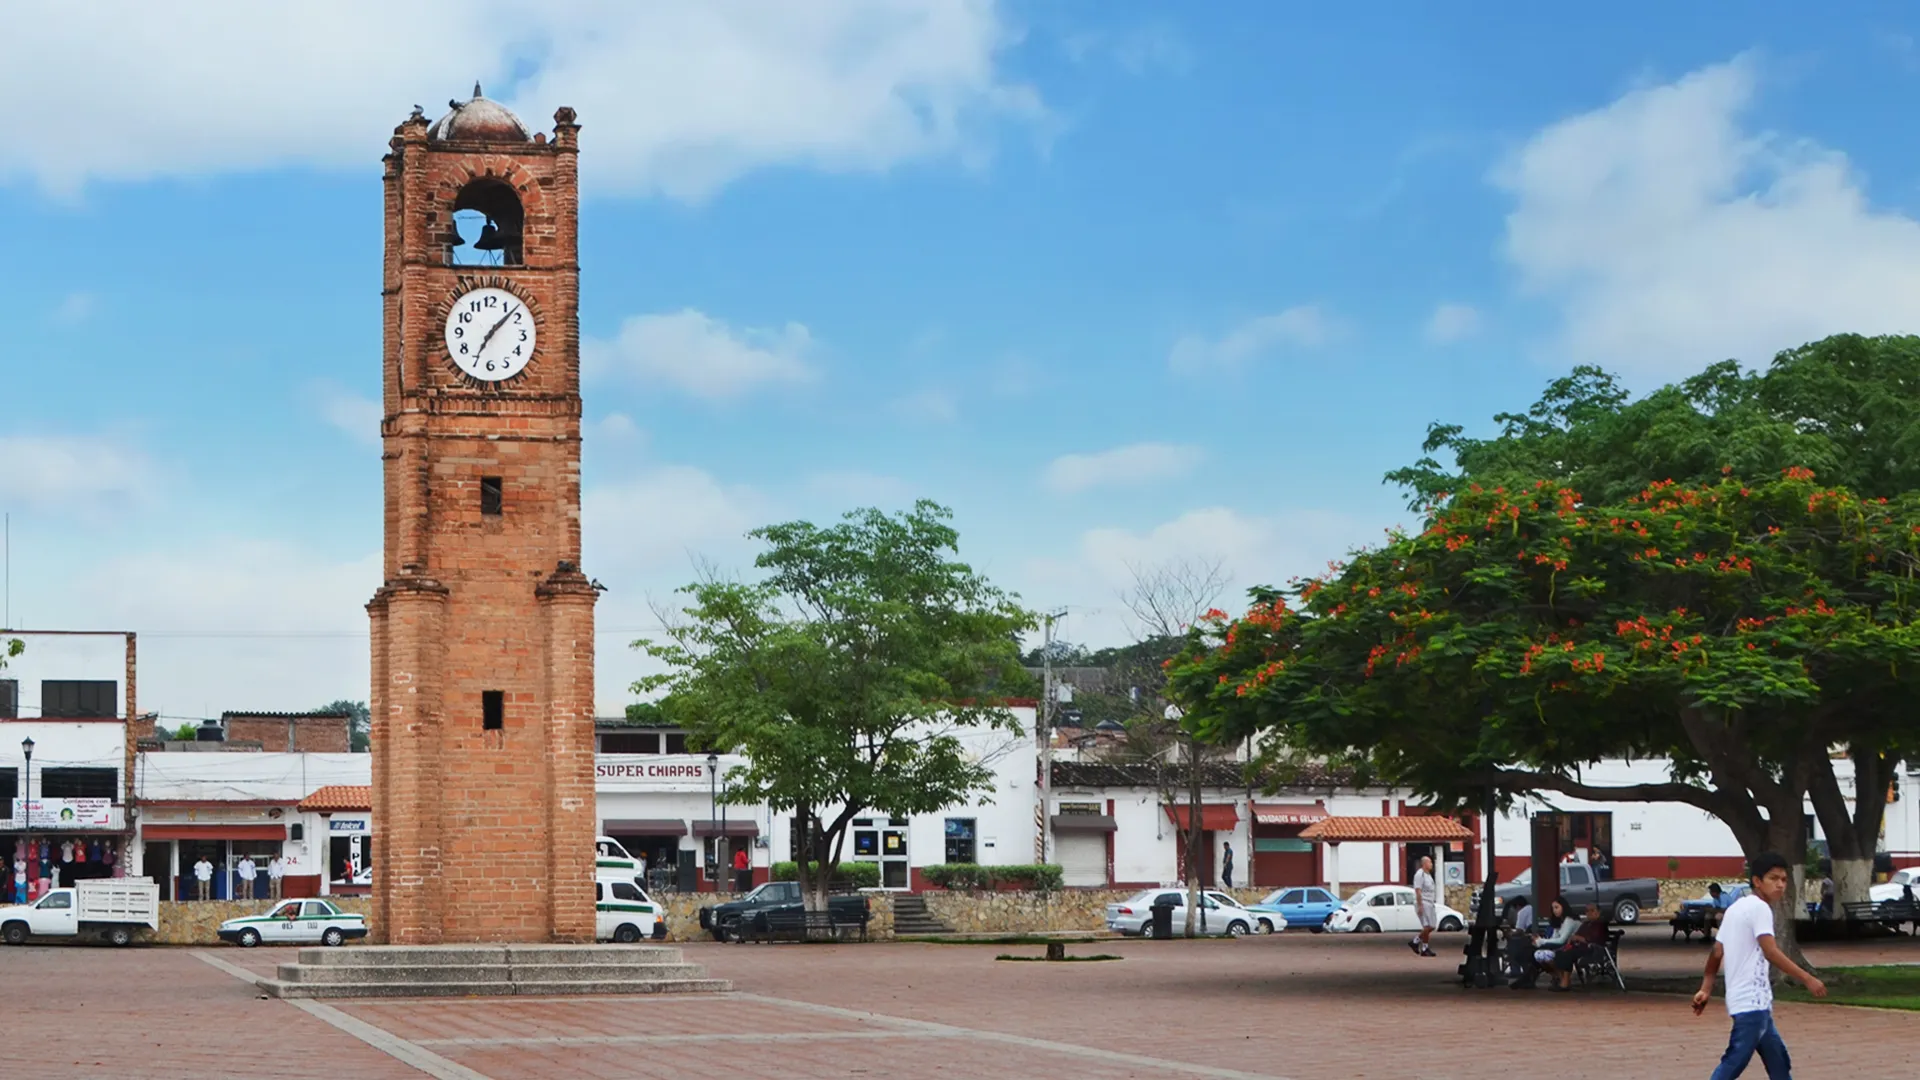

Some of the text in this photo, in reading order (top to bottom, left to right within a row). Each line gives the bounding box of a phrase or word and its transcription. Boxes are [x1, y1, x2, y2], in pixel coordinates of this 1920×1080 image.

[470, 301, 481, 312] 11
[484, 296, 497, 308] 12
[503, 302, 508, 312] 1
[459, 312, 472, 323] 10
[514, 312, 522, 324] 2
[454, 327, 464, 338] 9
[518, 329, 527, 341] 3
[460, 342, 468, 354] 8
[512, 345, 521, 356] 4
[472, 355, 480, 367] 7
[486, 360, 495, 371] 6
[501, 357, 510, 369] 5
[597, 765, 702, 777] SUPER CHIAPAS
